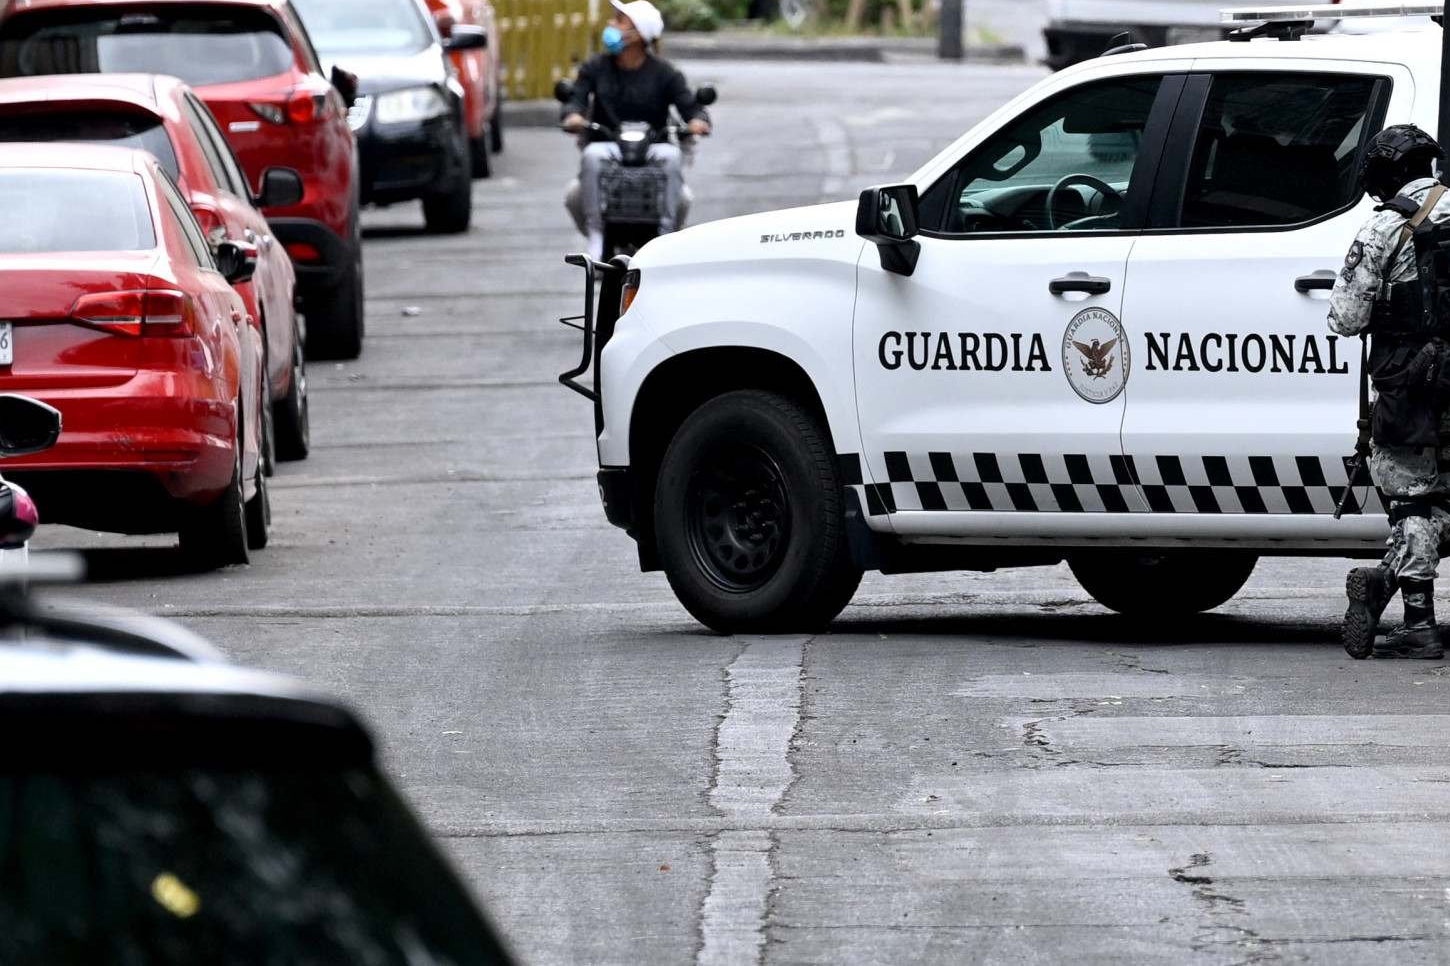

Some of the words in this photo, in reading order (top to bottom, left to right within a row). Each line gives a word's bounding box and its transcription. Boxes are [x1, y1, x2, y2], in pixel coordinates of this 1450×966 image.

[760, 229, 845, 243] SILVERADO
[878, 330, 1052, 372] GUARDIA
[1144, 332, 1349, 374] NACIONAL
